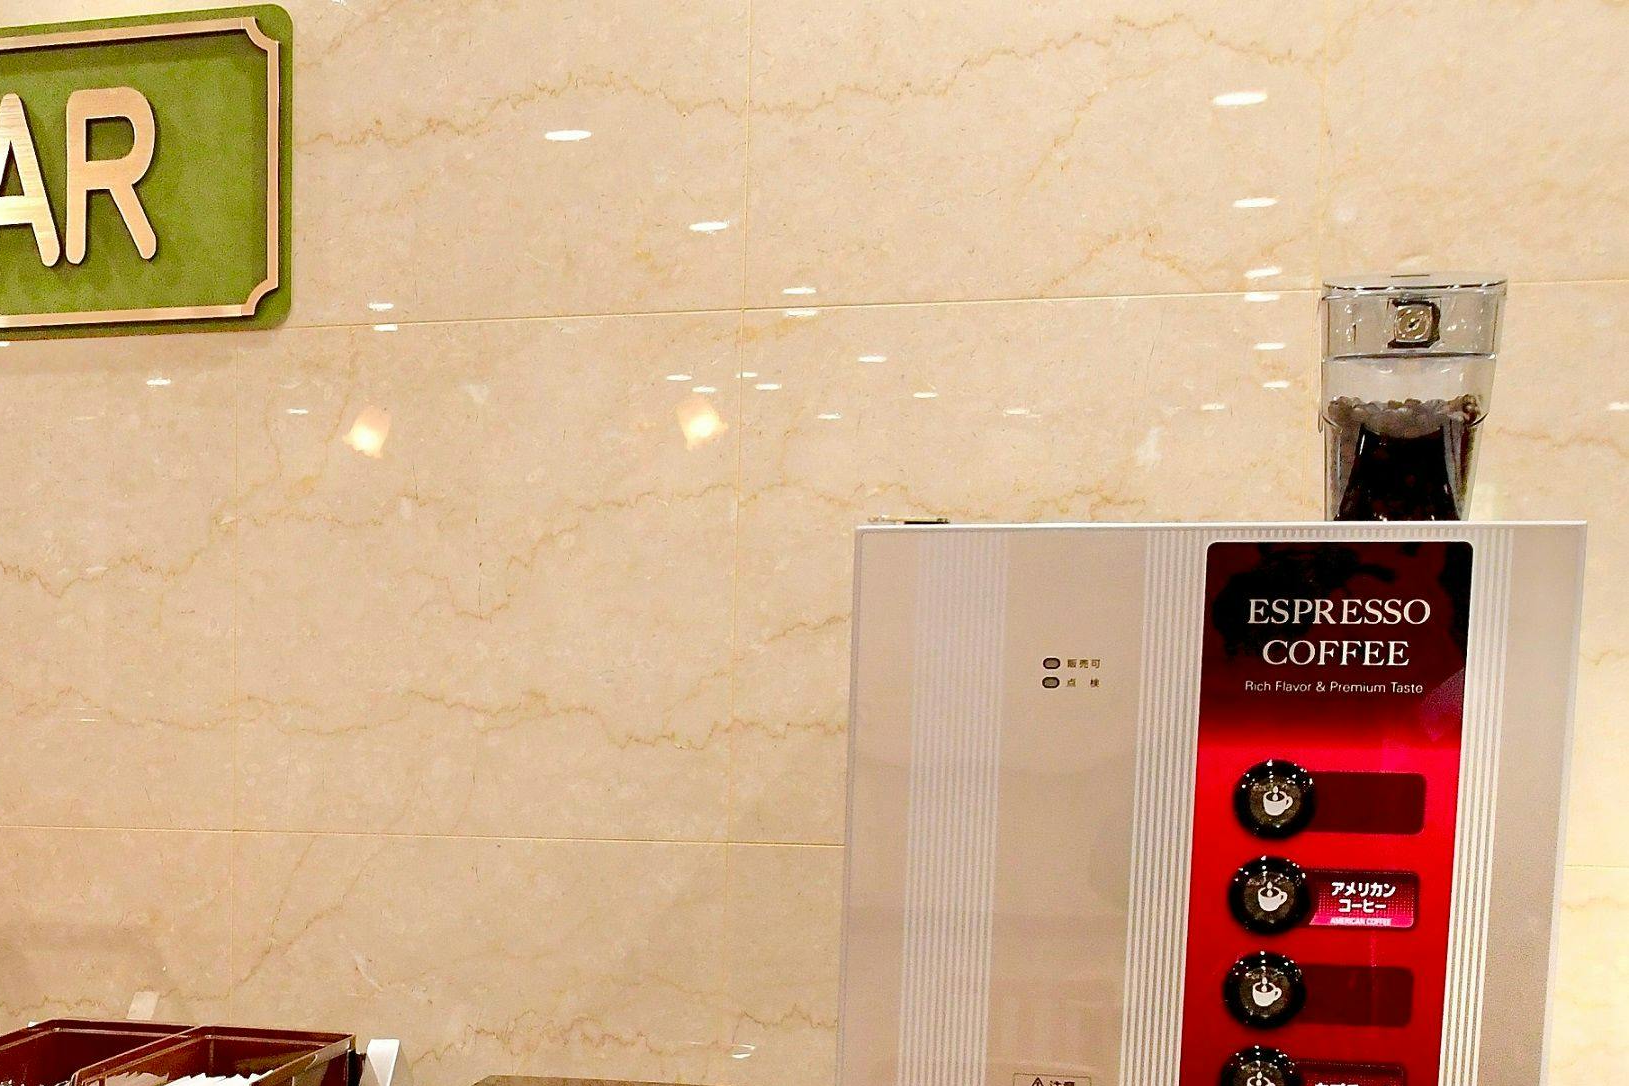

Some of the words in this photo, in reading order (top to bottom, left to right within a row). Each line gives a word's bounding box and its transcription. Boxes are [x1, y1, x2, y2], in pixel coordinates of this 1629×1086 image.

[1247, 598, 1431, 626] ESPRESSO
[1262, 640, 1410, 667] COFFEE
[1245, 680, 1271, 692] Rich
[1275, 680, 1312, 692] Flavor
[1315, 681, 1326, 692] &
[1329, 681, 1386, 693] Premium
[1390, 681, 1424, 694] Taste
[1331, 882, 1396, 898] アメリカン
[1338, 899, 1386, 914] コーヒー
